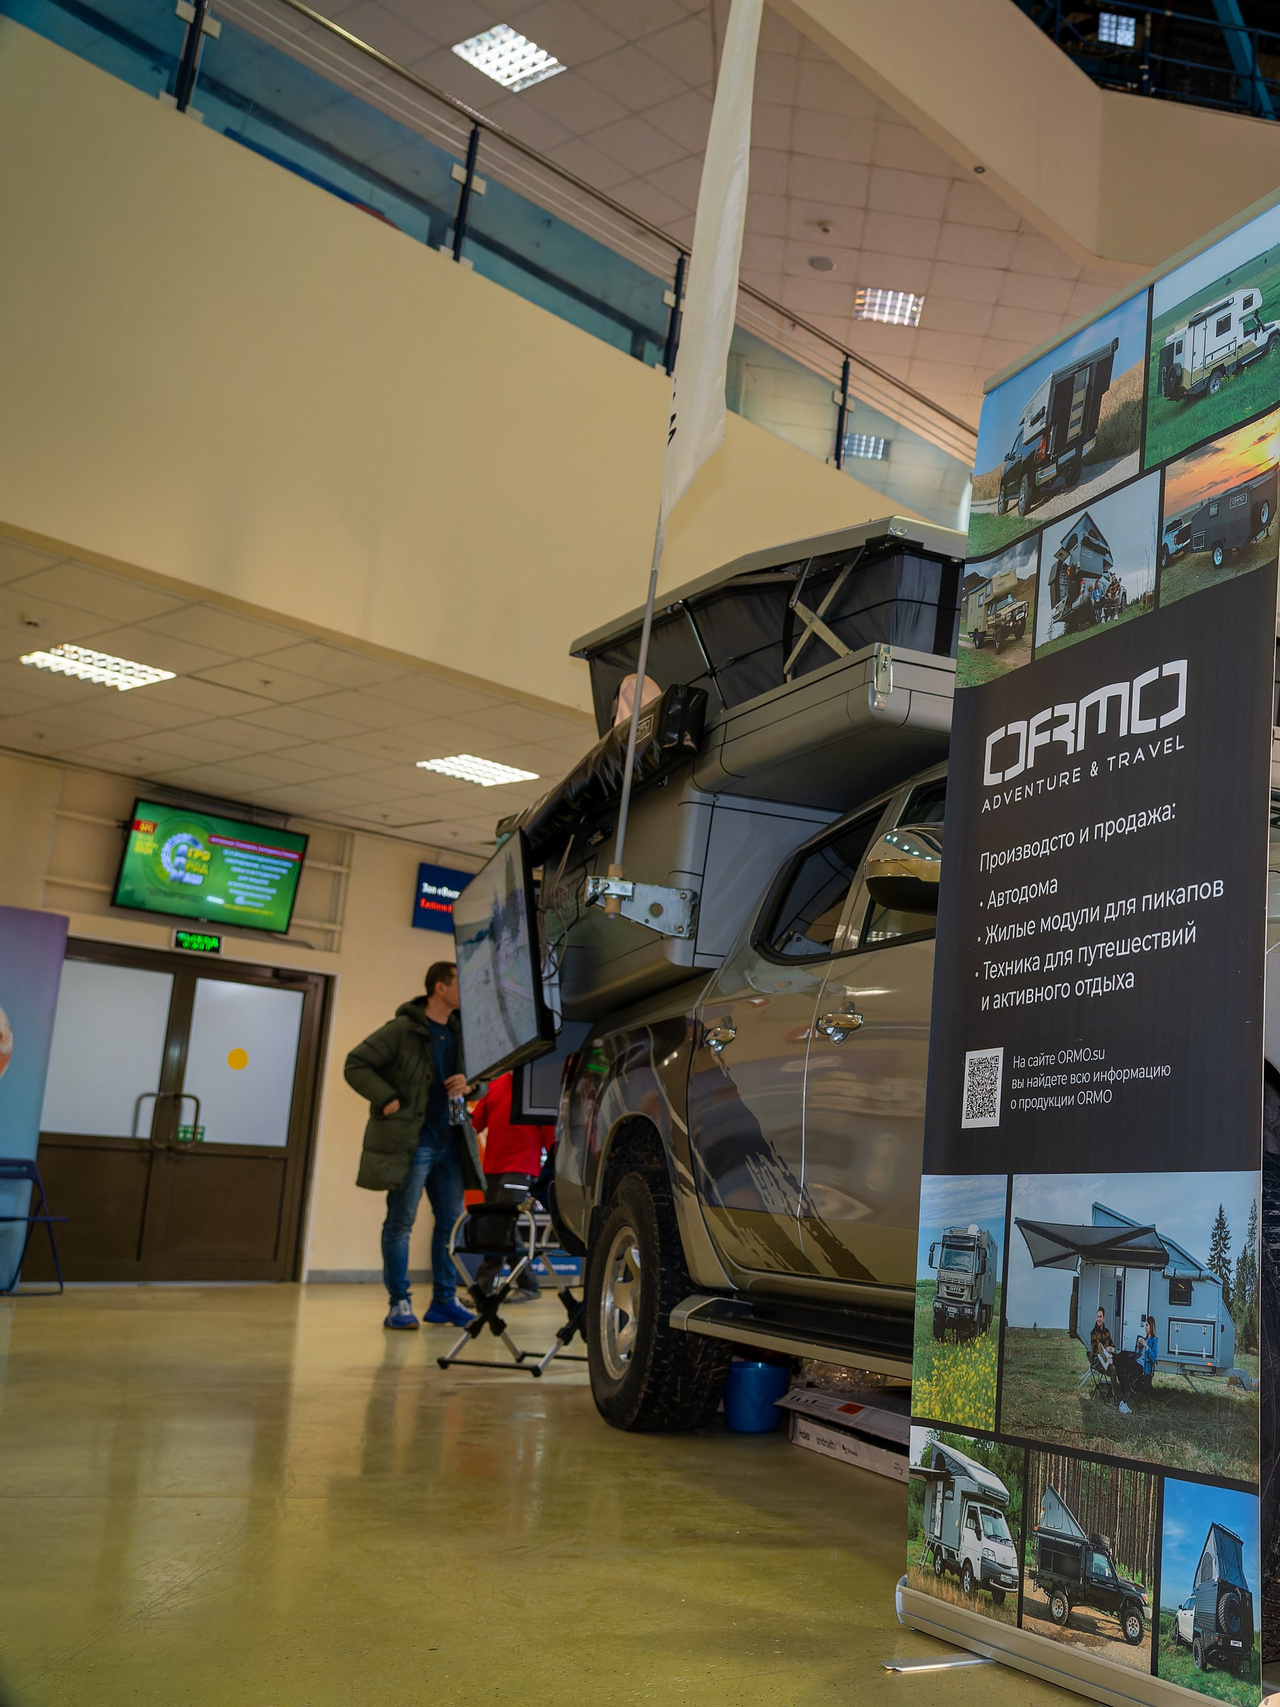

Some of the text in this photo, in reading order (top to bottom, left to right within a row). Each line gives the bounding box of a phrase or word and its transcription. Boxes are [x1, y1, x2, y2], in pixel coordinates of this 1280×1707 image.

[982, 659, 1189, 787] ORMO
[981, 735, 1186, 814] ADVENTURE & TRAVEL
[979, 802, 1177, 874] Производсто и продажа:
[984, 878, 1224, 946] Жилые модули для пикапов
[986, 877, 1058, 910] Автодома
[983, 920, 1197, 981] Техника для путешествий
[980, 970, 1135, 1012] и активного отдыха
[1011, 1064, 1172, 1090] вы найдете всю информацию
[1012, 1047, 1106, 1069] На сайте ORMO.su
[1010, 1088, 1113, 1112] о продукции ORMO
